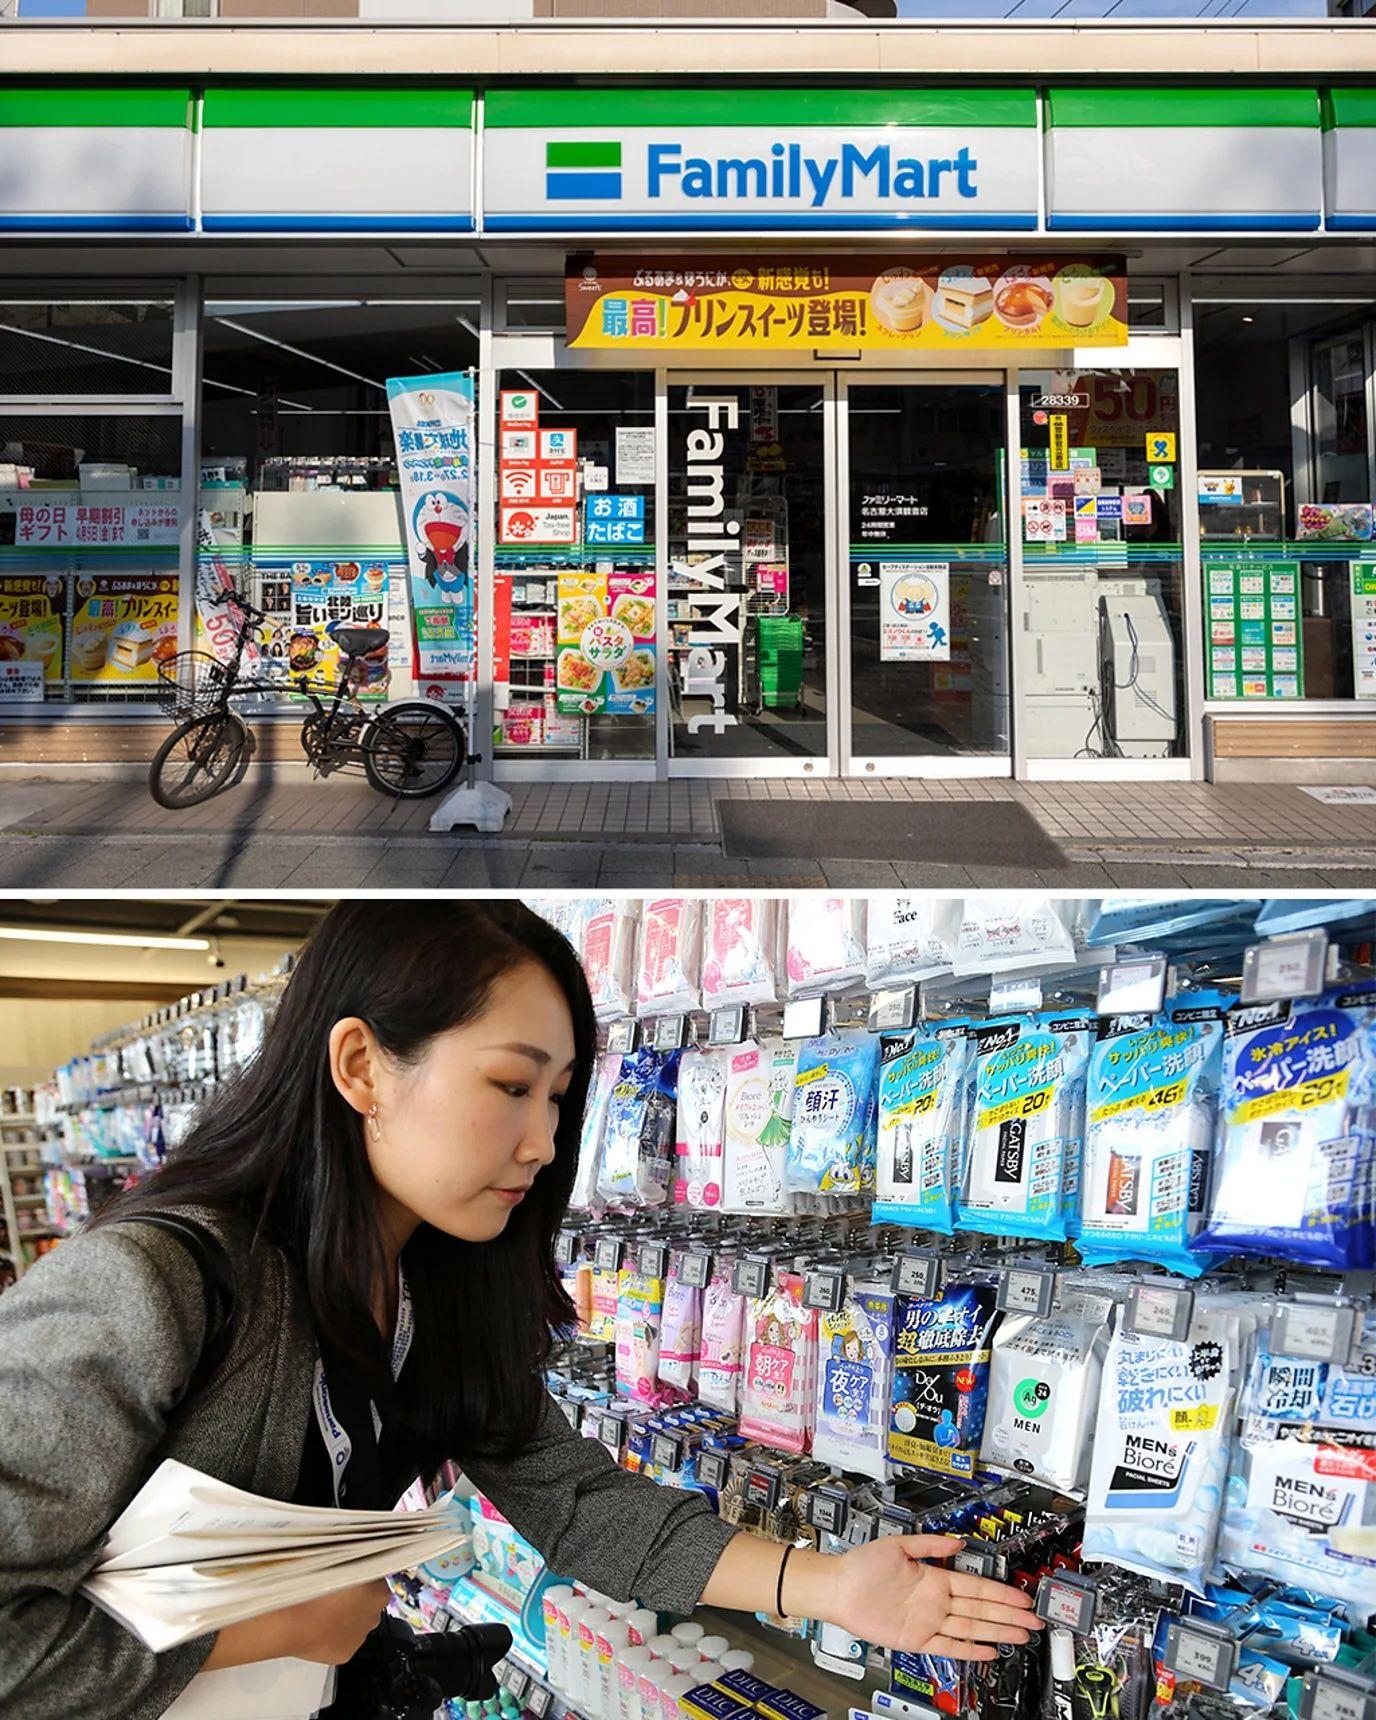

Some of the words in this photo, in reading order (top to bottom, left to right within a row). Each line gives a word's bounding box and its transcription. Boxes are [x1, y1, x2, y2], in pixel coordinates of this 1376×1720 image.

[647, 144, 978, 207] FamilyMart
[593, 497, 638, 517] お酒
[862, 495, 919, 505] ファミリーマート
[19, 507, 66, 524] 母の日
[19, 525, 68, 542] ギフト
[587, 523, 643, 542] たばこ
[672, 395, 740, 734] FamilyMart
[1251, 1023, 1338, 1064] 氷冷アイス!
[805, 1089, 840, 1112] 顔汗
[1005, 1123, 1023, 1181] GATSBY
[755, 1353, 789, 1377] 朝ケア
[830, 1368, 869, 1395] 夜ケア
[1023, 1390, 1038, 1407] Ag
[1117, 1384, 1207, 1414] 破れにくい
[1266, 1389, 1312, 1410] 冷却
[1012, 1417, 1042, 1435] MEN
[1123, 1447, 1176, 1475] Bioré
[1273, 1488, 1334, 1520] Bioré
[728, 1671, 767, 1693] DHC
[695, 1686, 732, 1711] DHC
[775, 1692, 813, 1718] DHC
